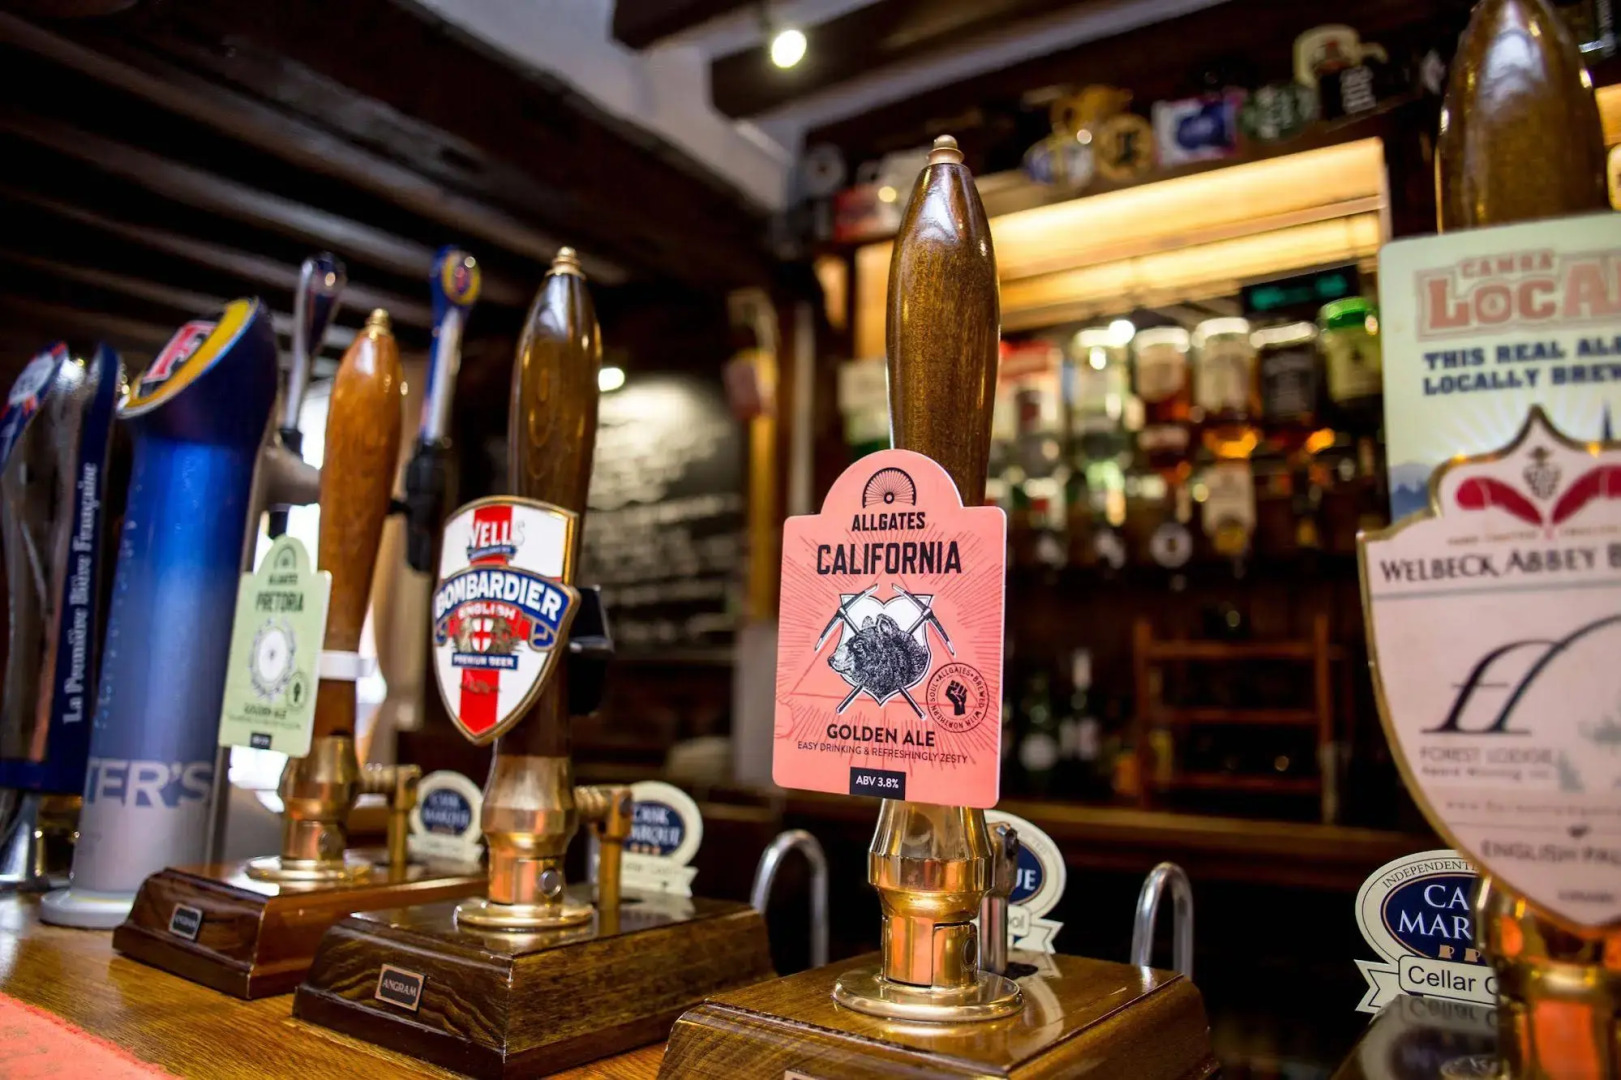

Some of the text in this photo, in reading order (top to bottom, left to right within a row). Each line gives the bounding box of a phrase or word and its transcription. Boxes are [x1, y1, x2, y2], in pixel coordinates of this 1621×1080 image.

[1429, 262, 1621, 330] LOCA
[1423, 348, 1486, 371] THIS
[1496, 341, 1565, 364] REAL
[1424, 369, 1540, 396] LOCALLY
[851, 511, 926, 532] ALLGATES
[816, 540, 962, 575] CALIFORNIA
[1380, 552, 1499, 583] WELBECK
[1505, 546, 1597, 574] ABBEY
[435, 570, 562, 622] BOMBARDIER
[458, 603, 516, 620] ENGLISH
[826, 723, 936, 748] GOLDEN ALE
[797, 741, 968, 764] EASY DRINKING & REFRESHINGLY ZESTY
[855, 774, 899, 790] ABV 3.8%
[1382, 861, 1475, 888] INDEPENDENT
[382, 979, 417, 997] ANGRAM
[1408, 965, 1476, 992] Cellar
